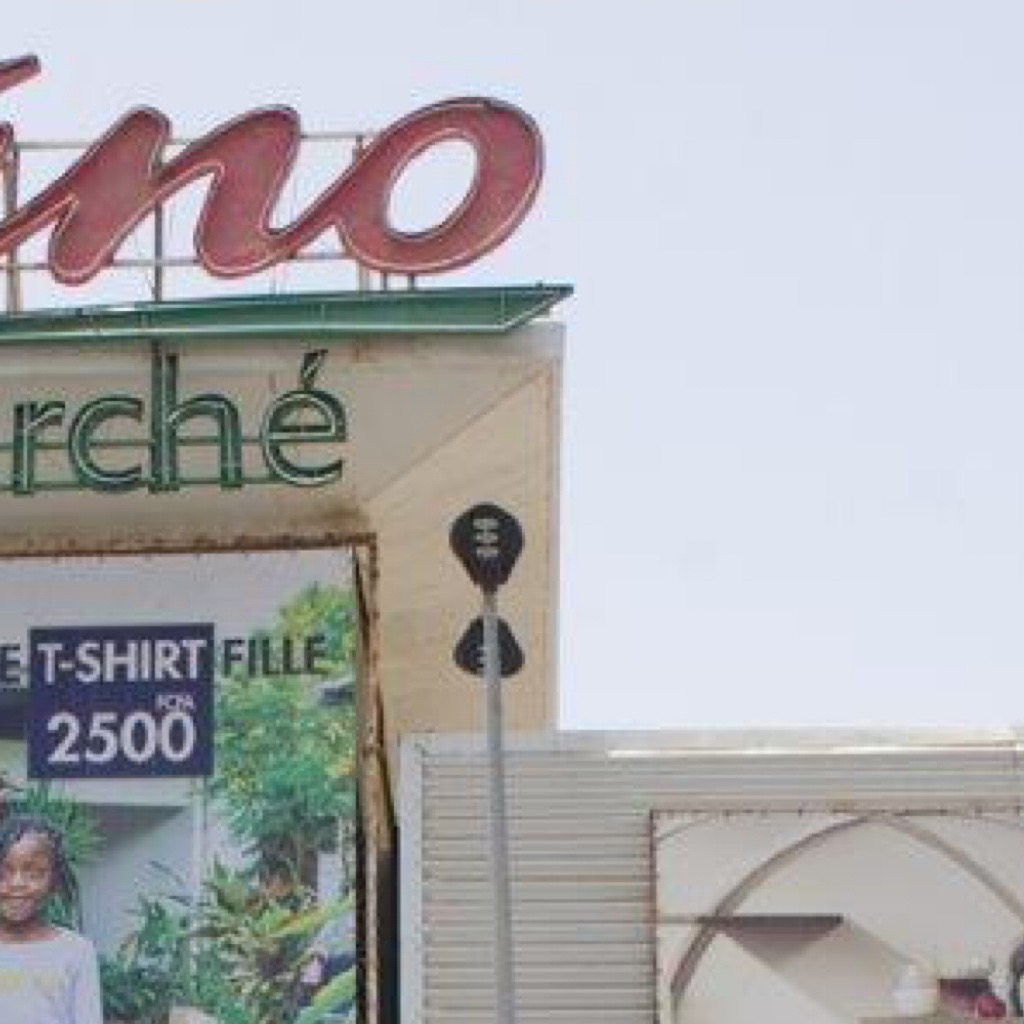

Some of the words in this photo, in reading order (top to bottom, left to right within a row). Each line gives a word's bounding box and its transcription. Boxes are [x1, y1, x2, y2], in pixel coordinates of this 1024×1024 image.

[36, 639, 208, 684] T-SHIRT
[222, 635, 326, 678] FILLE
[46, 710, 196, 765] 2500
